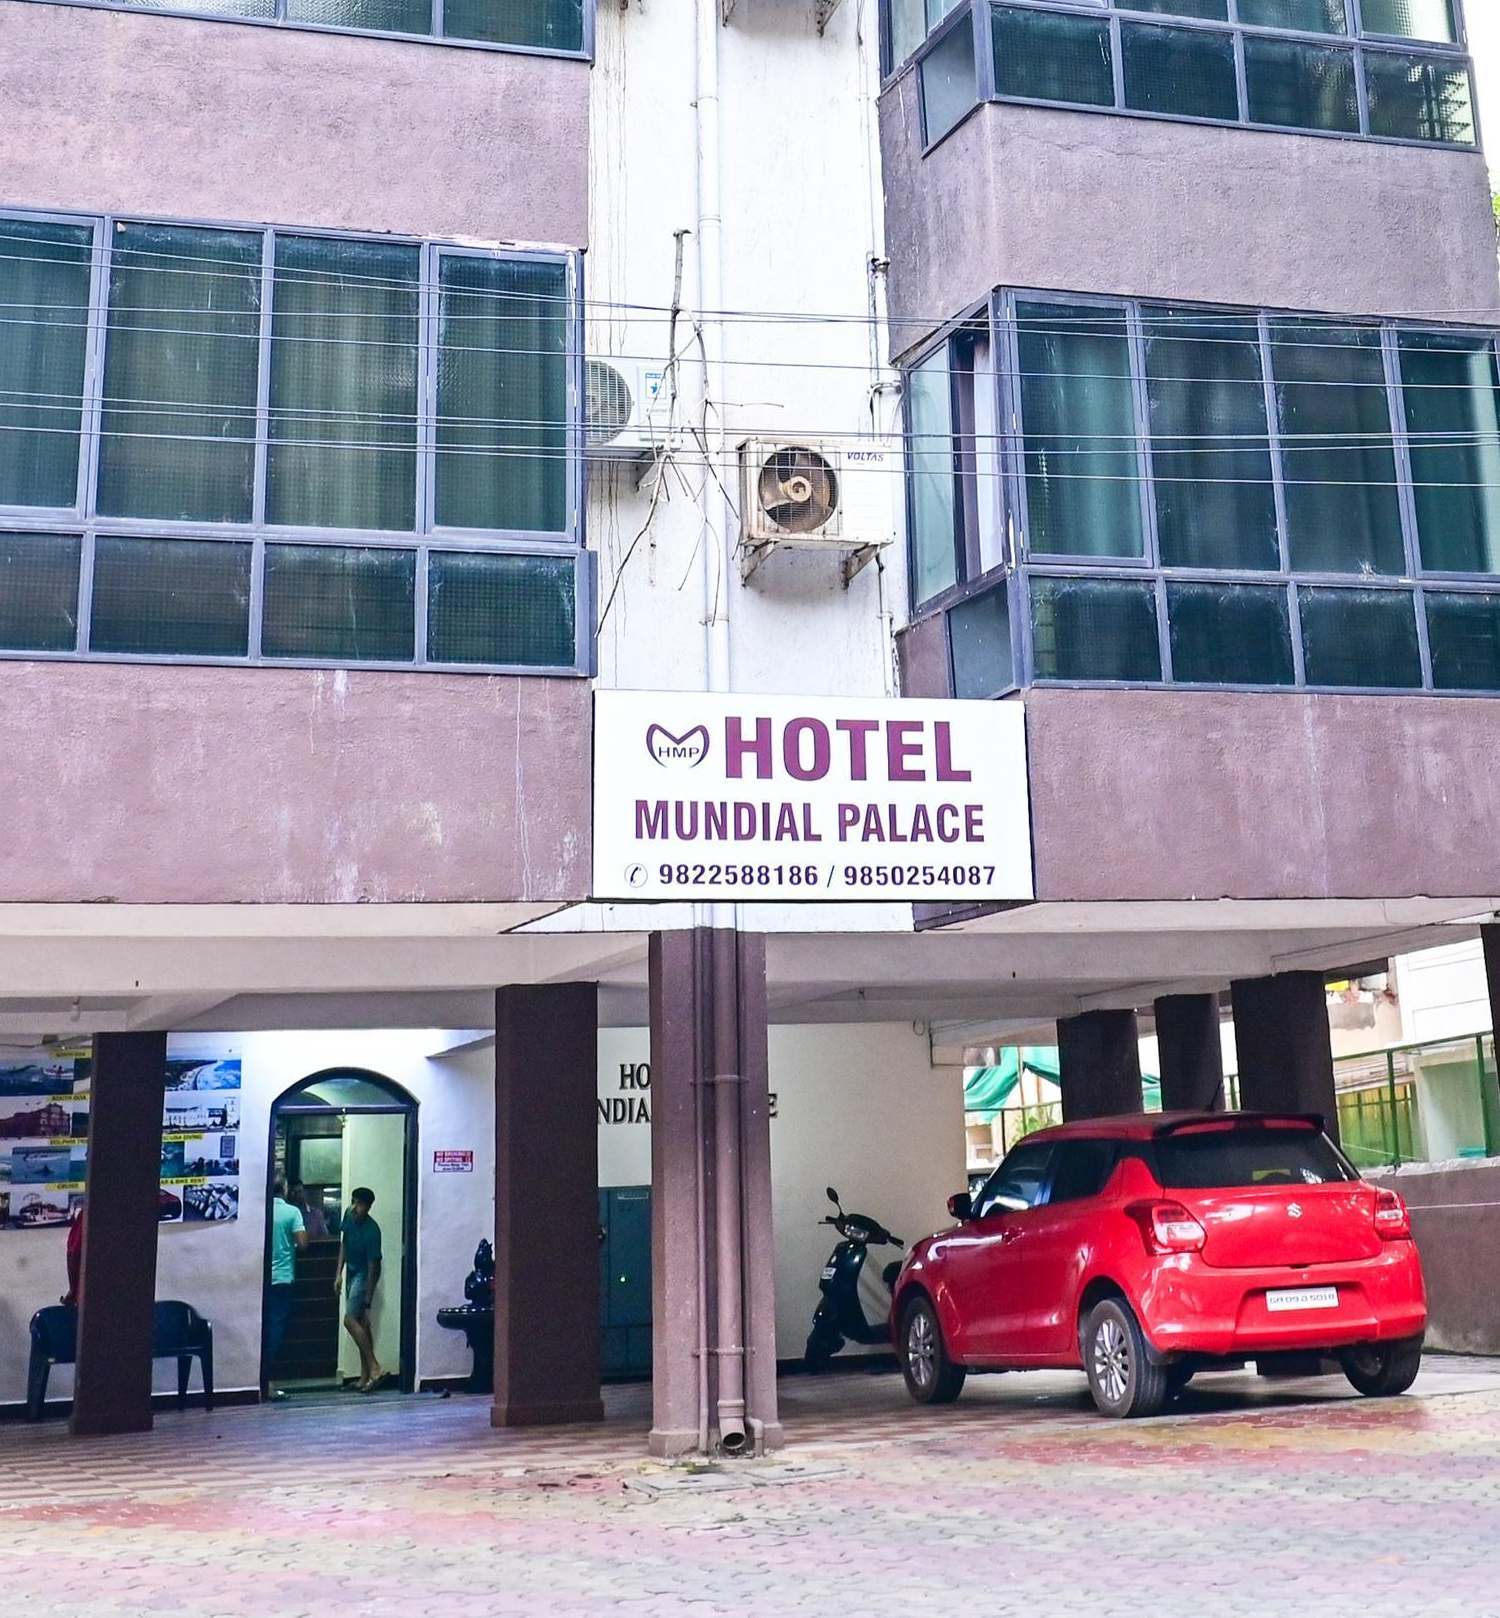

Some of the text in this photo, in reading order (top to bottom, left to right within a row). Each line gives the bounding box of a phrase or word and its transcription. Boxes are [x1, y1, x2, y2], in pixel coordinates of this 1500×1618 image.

[847, 451, 884, 462] VOLTAS
[658, 745, 700, 759] HMP
[724, 716, 972, 782] HOTEL
[634, 799, 985, 842] MUNDIAL PALACE
[659, 863, 818, 886] 9822588186
[843, 864, 996, 886] 9850254087
